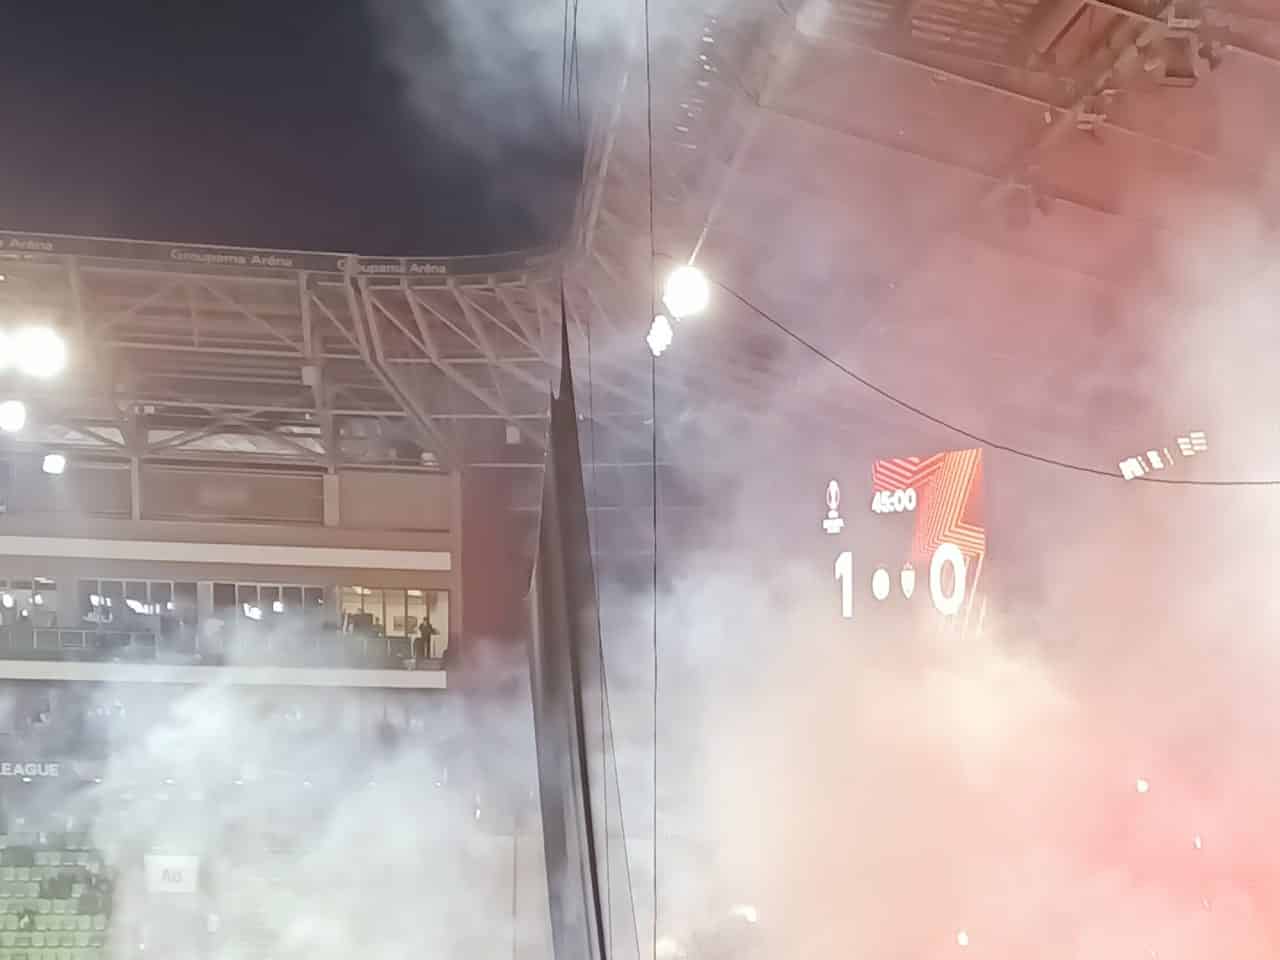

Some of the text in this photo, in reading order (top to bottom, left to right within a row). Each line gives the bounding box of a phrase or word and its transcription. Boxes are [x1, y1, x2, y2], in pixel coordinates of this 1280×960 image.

[835, 542, 966, 619] 1 0
[0, 761, 59, 777] EAGUE
